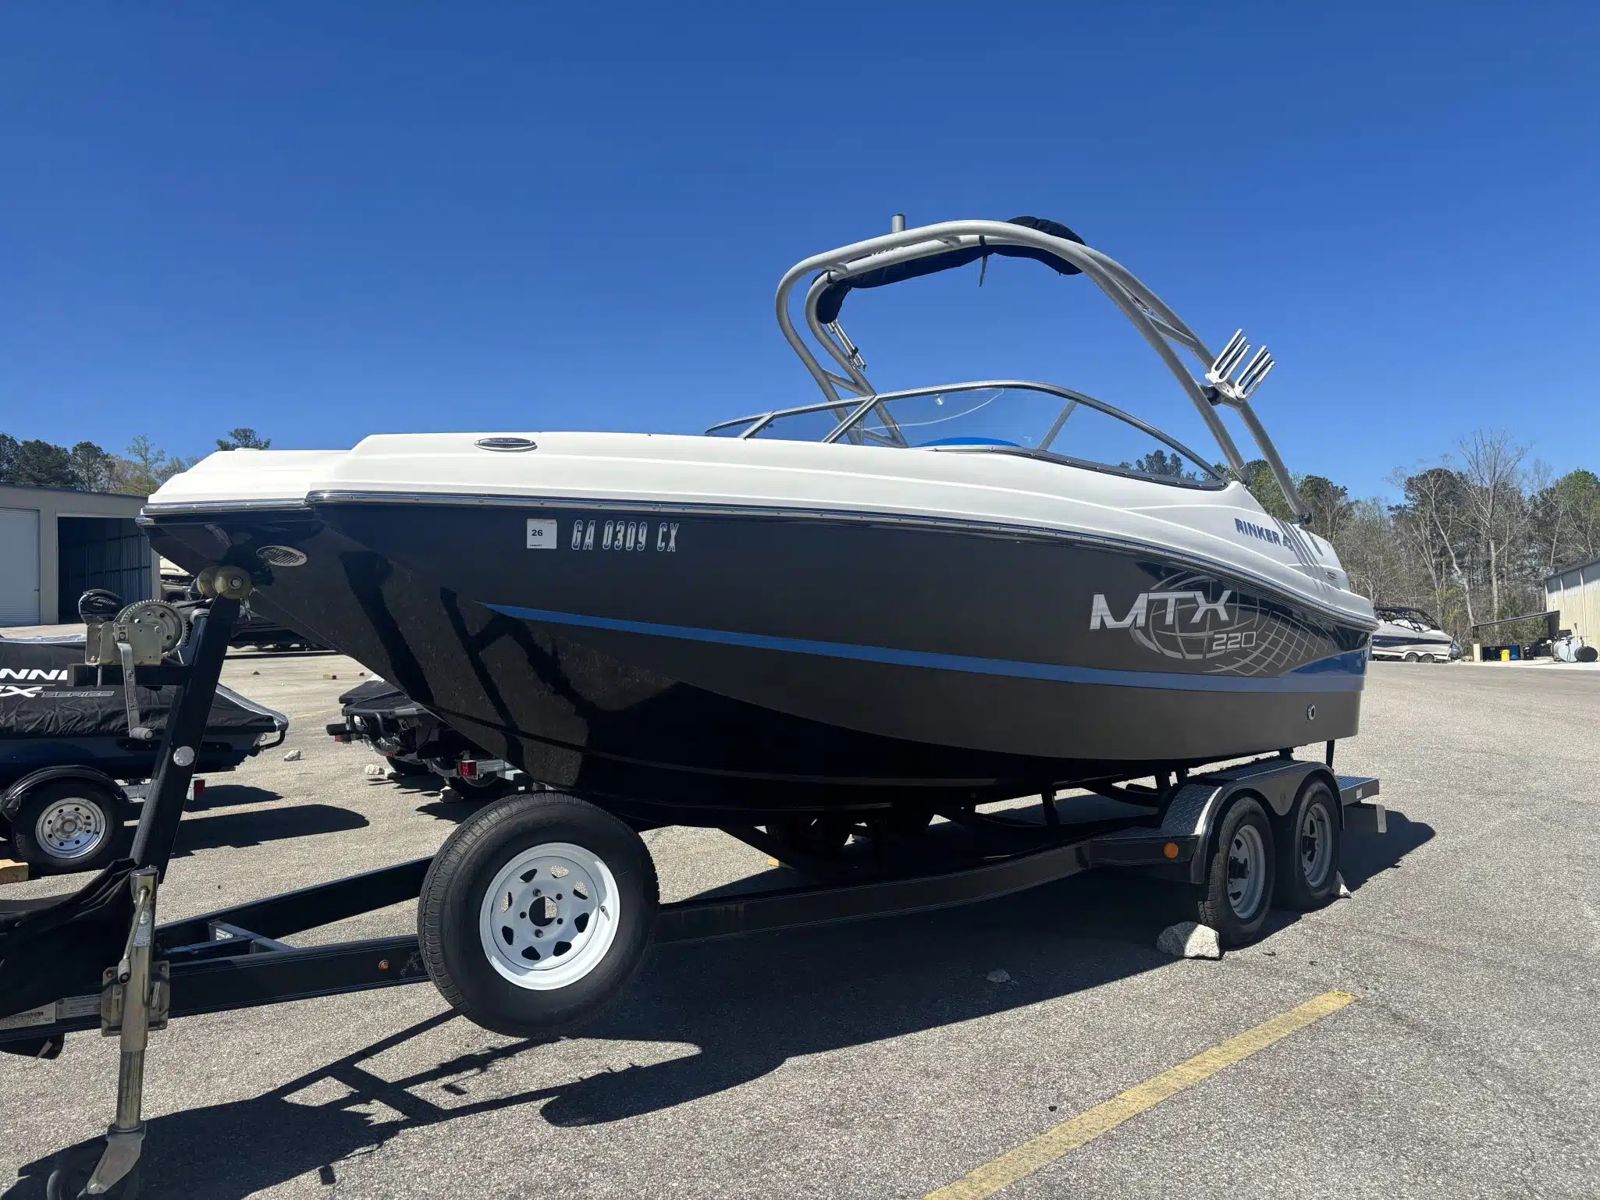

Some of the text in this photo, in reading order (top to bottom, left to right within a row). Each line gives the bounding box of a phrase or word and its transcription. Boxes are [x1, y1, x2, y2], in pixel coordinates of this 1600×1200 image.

[531, 529, 543, 537] 26
[571, 519, 680, 553] GA 0309 CX
[1234, 517, 1281, 546] RINKER
[1089, 590, 1232, 630] MTX
[1212, 631, 1257, 651] 220
